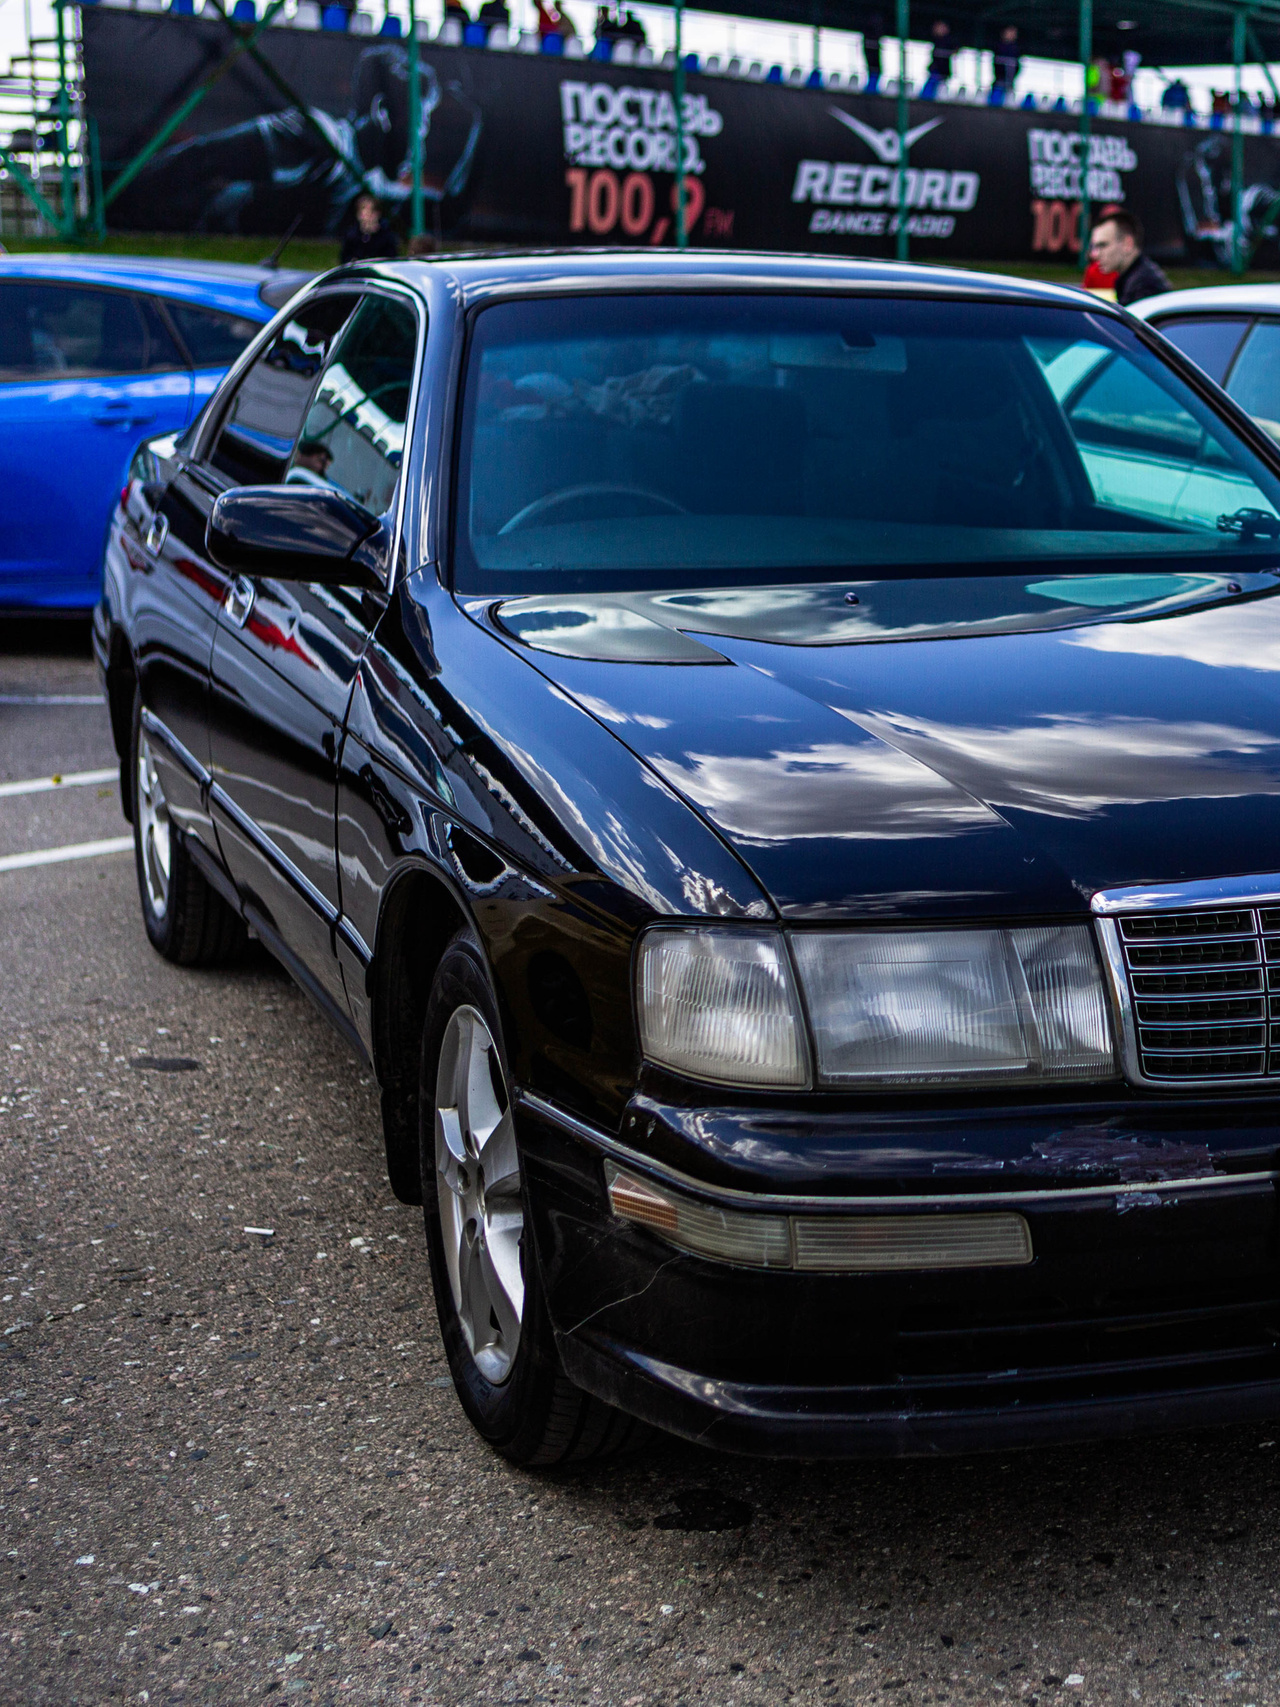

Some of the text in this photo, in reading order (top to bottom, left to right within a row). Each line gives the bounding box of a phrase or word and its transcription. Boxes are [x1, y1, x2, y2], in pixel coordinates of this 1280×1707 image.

[565, 167, 705, 246] 100,9
[791, 159, 981, 212] RECORD
[808, 209, 889, 236] DANCE
